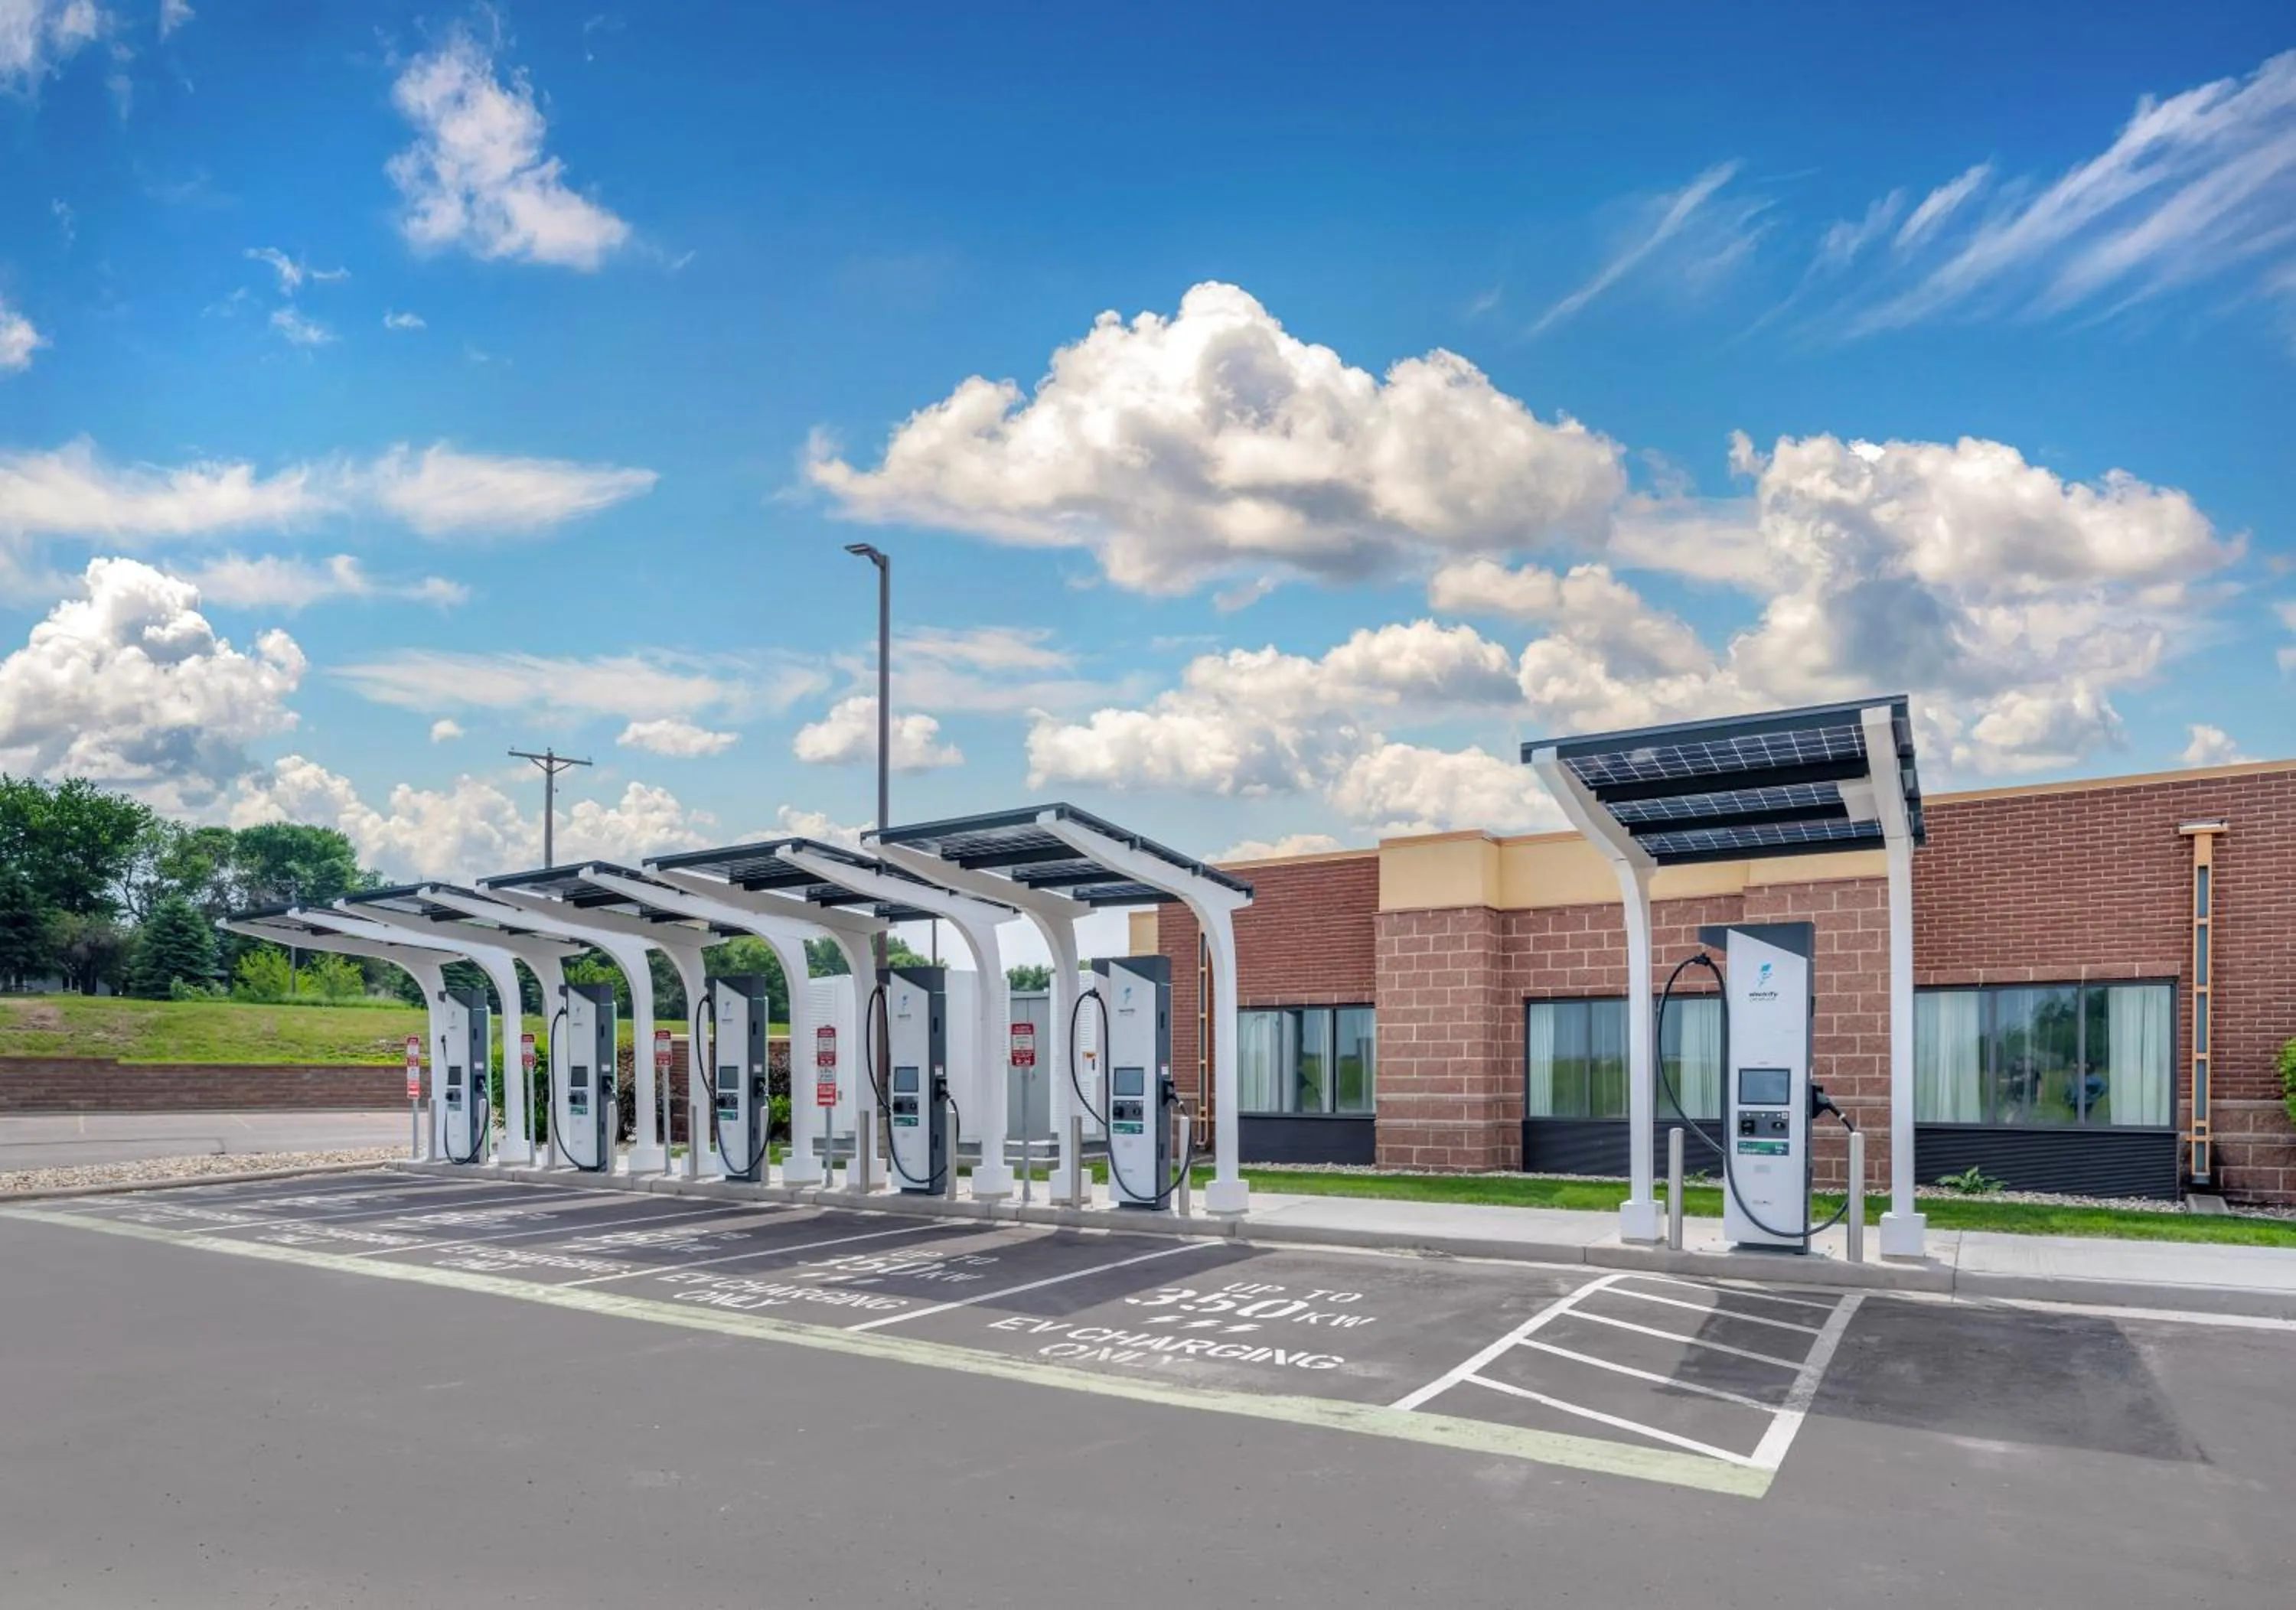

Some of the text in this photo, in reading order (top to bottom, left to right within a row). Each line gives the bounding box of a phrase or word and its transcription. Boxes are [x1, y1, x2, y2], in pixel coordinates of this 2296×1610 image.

[1124, 1288, 1309, 1318] 350
[1223, 1281, 1363, 1302] UP TO
[987, 1316, 1345, 1369] EV CHARGING
[1038, 1342, 1196, 1367] ONLY
